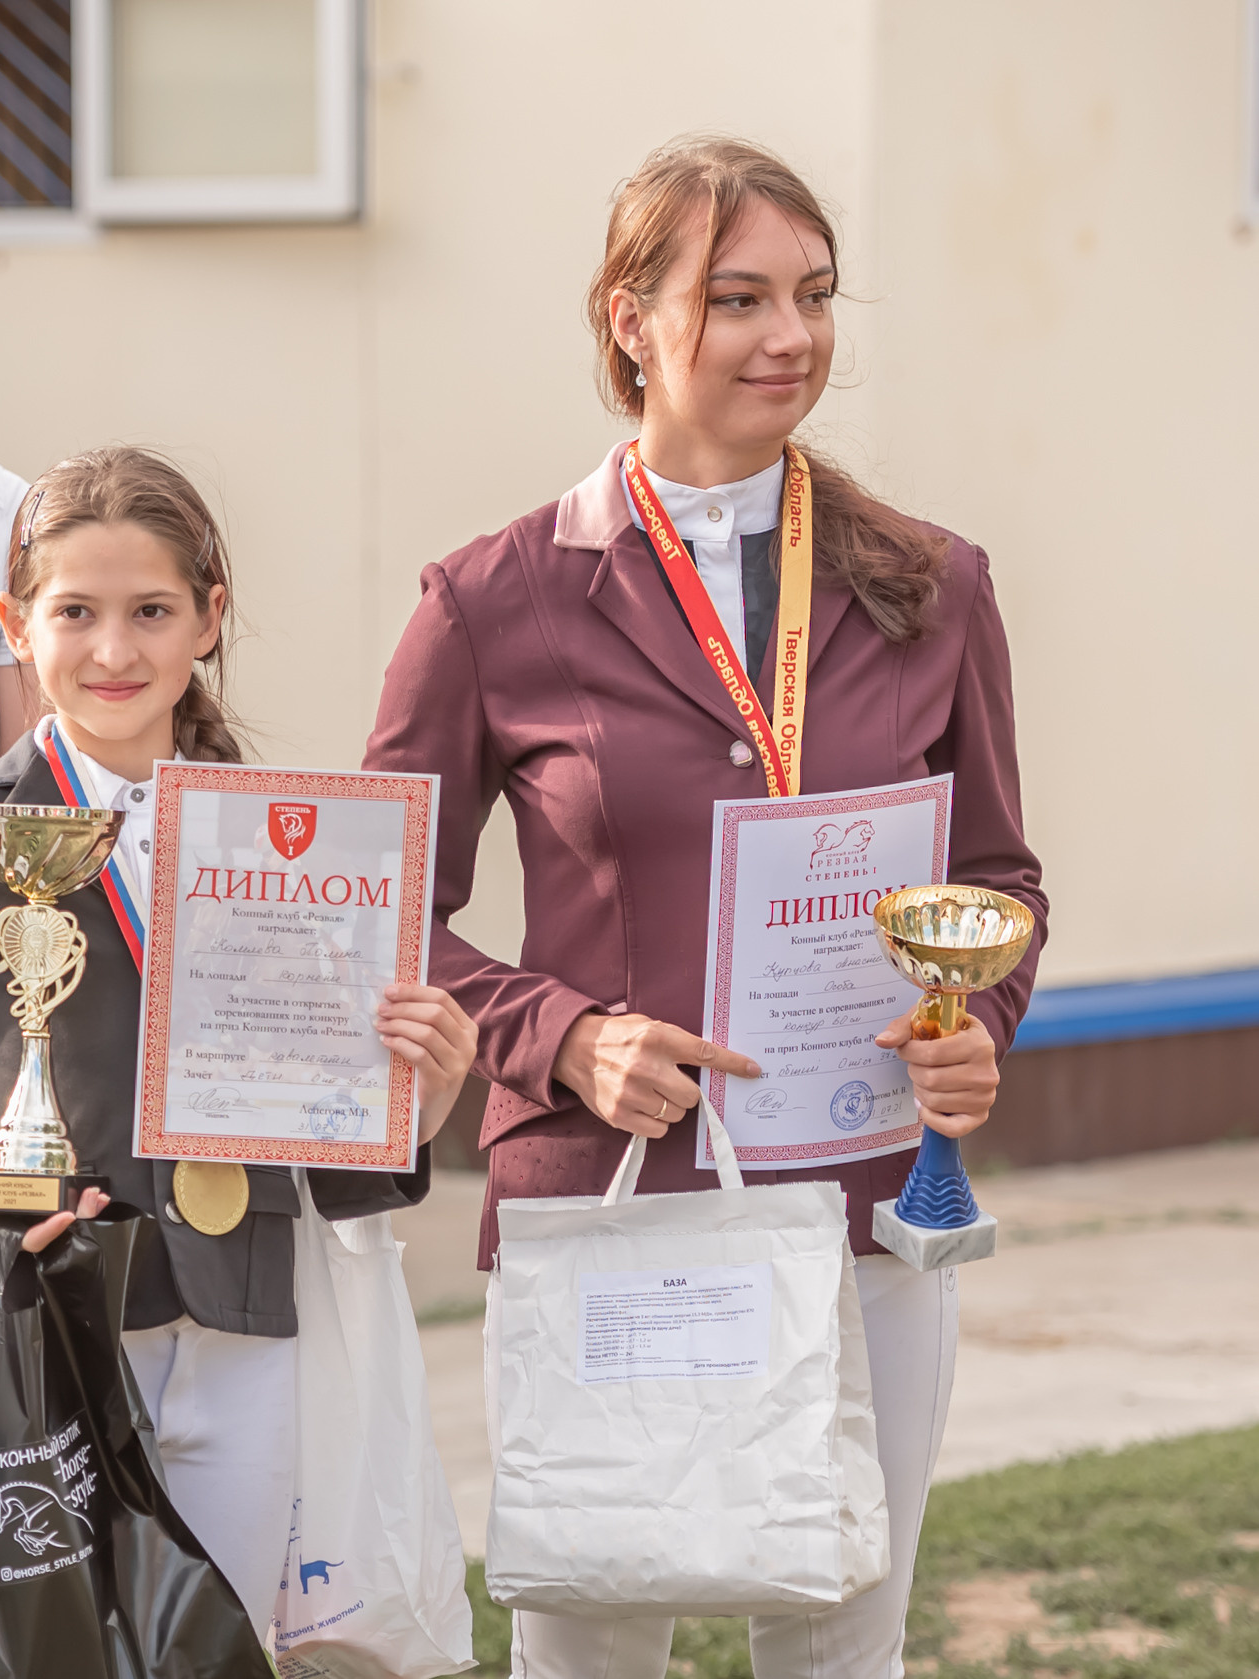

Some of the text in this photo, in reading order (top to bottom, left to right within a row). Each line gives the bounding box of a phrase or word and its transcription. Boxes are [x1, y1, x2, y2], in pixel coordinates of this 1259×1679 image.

[781, 626, 803, 717] Тверская
[818, 855, 867, 868] РЕЗВАЯ
[806, 868, 868, 882] СТЕПЕНЬ
[186, 867, 392, 908] ДИПЛОМ
[231, 907, 274, 920] Конный
[276, 909, 300, 922] клуб
[257, 923, 317, 937] награждает:
[791, 933, 825, 946] Конный
[828, 930, 848, 943] клуб
[813, 942, 864, 956] награждает:
[189, 969, 246, 982] На лошади
[749, 989, 799, 1000] На лошади
[227, 994, 240, 1005] За
[242, 997, 281, 1008] участие
[292, 1000, 341, 1011] открытых
[769, 1009, 780, 1019] За
[782, 1006, 816, 1018] участие
[825, 998, 885, 1015] соревнованиях
[886, 995, 896, 1003] по
[214, 1009, 349, 1026] соревнованиях по конкуру
[200, 1022, 363, 1039] на приз Конного клуба «Резвая»
[778, 1045, 798, 1055] приз
[801, 1041, 837, 1052] Конного
[839, 1038, 862, 1049] клуба
[185, 1049, 246, 1063] В маршруте
[184, 1068, 213, 1080] Зачёт
[663, 1278, 687, 1288] БАЗА
[0, 1420, 82, 1469] КОННЫЙ БУТИК
[317, 1600, 364, 1630] животных)
